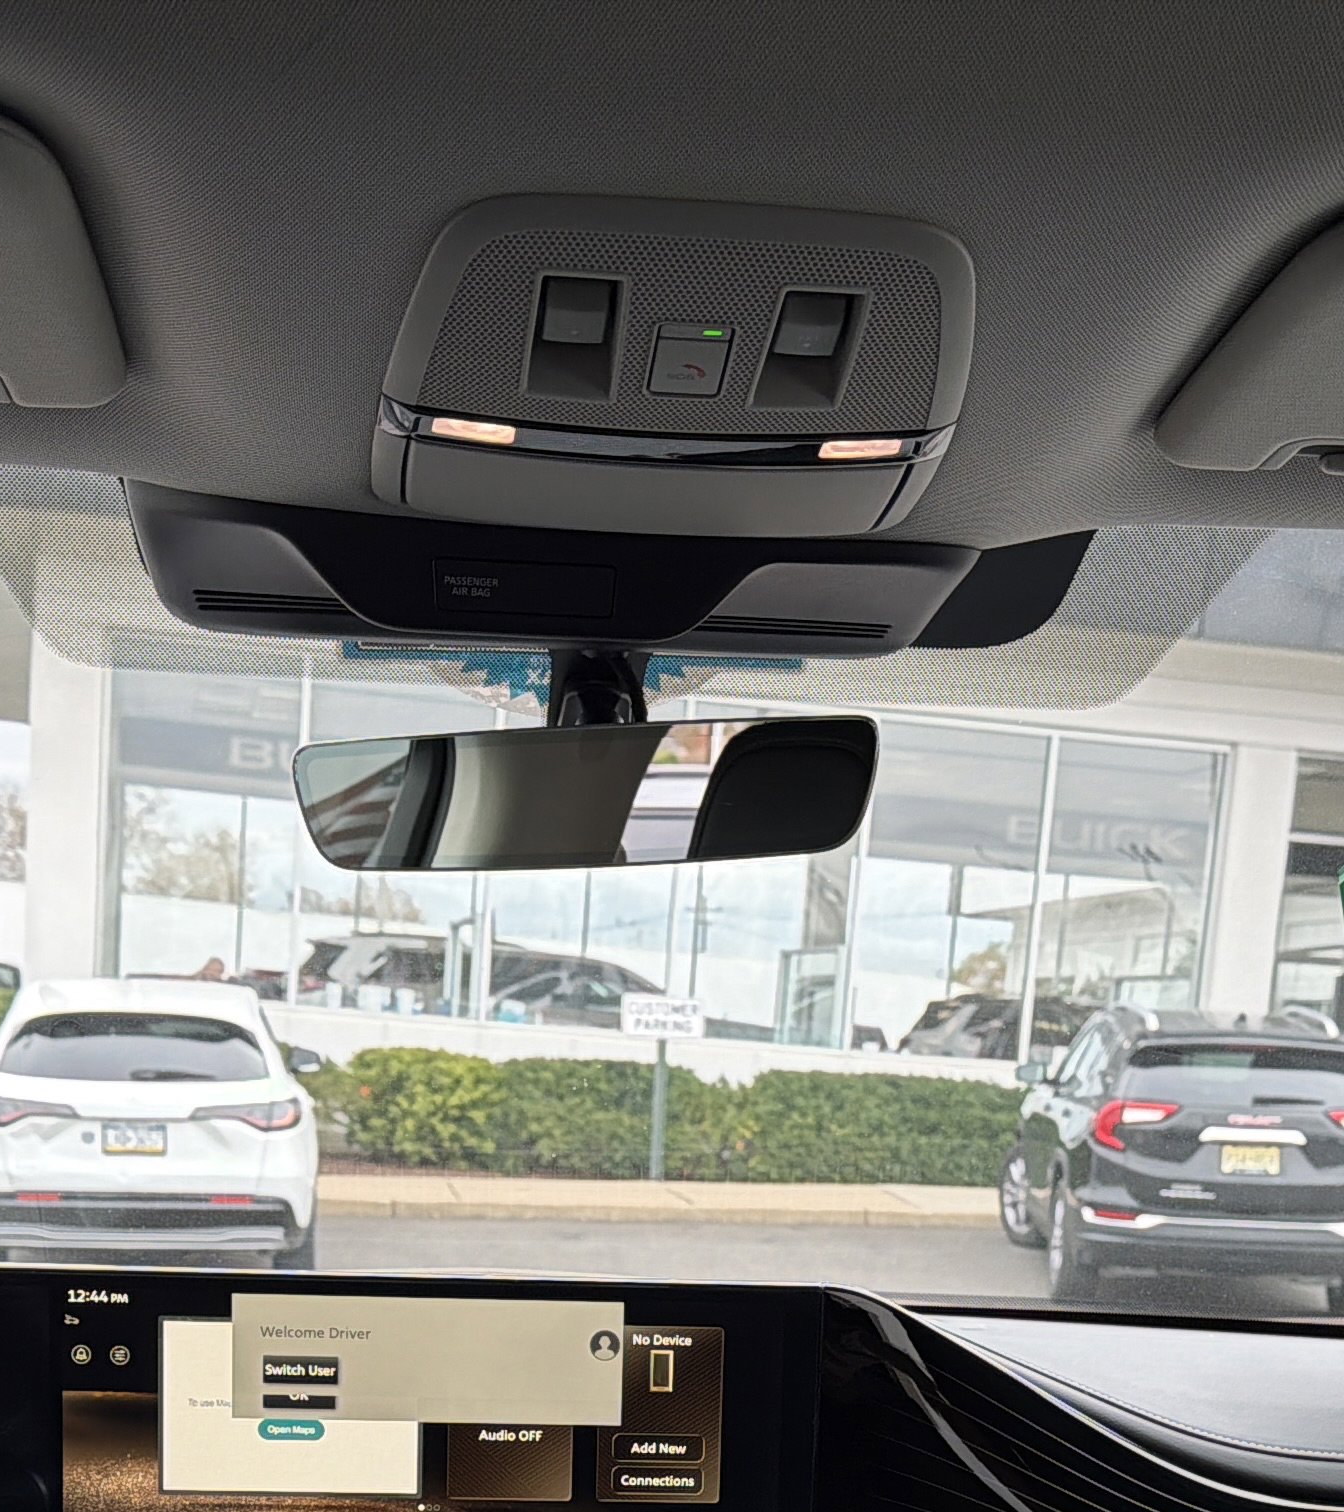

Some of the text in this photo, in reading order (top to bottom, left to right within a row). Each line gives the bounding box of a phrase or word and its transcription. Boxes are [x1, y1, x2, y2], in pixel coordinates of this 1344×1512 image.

[444, 576, 499, 587] PASSENGER
[451, 587, 491, 598] AIR BAG
[633, 1017, 693, 1034] PARKING
[67, 1289, 129, 1304] 12:44 PM
[260, 1325, 371, 1340] Welcome Driver
[632, 1333, 693, 1347] No Device
[264, 1363, 337, 1377] Switch User
[267, 1425, 316, 1436] Open Maps
[478, 1429, 543, 1443] Audio OFF
[630, 1442, 687, 1455] Add New
[620, 1474, 695, 1487] Connections
